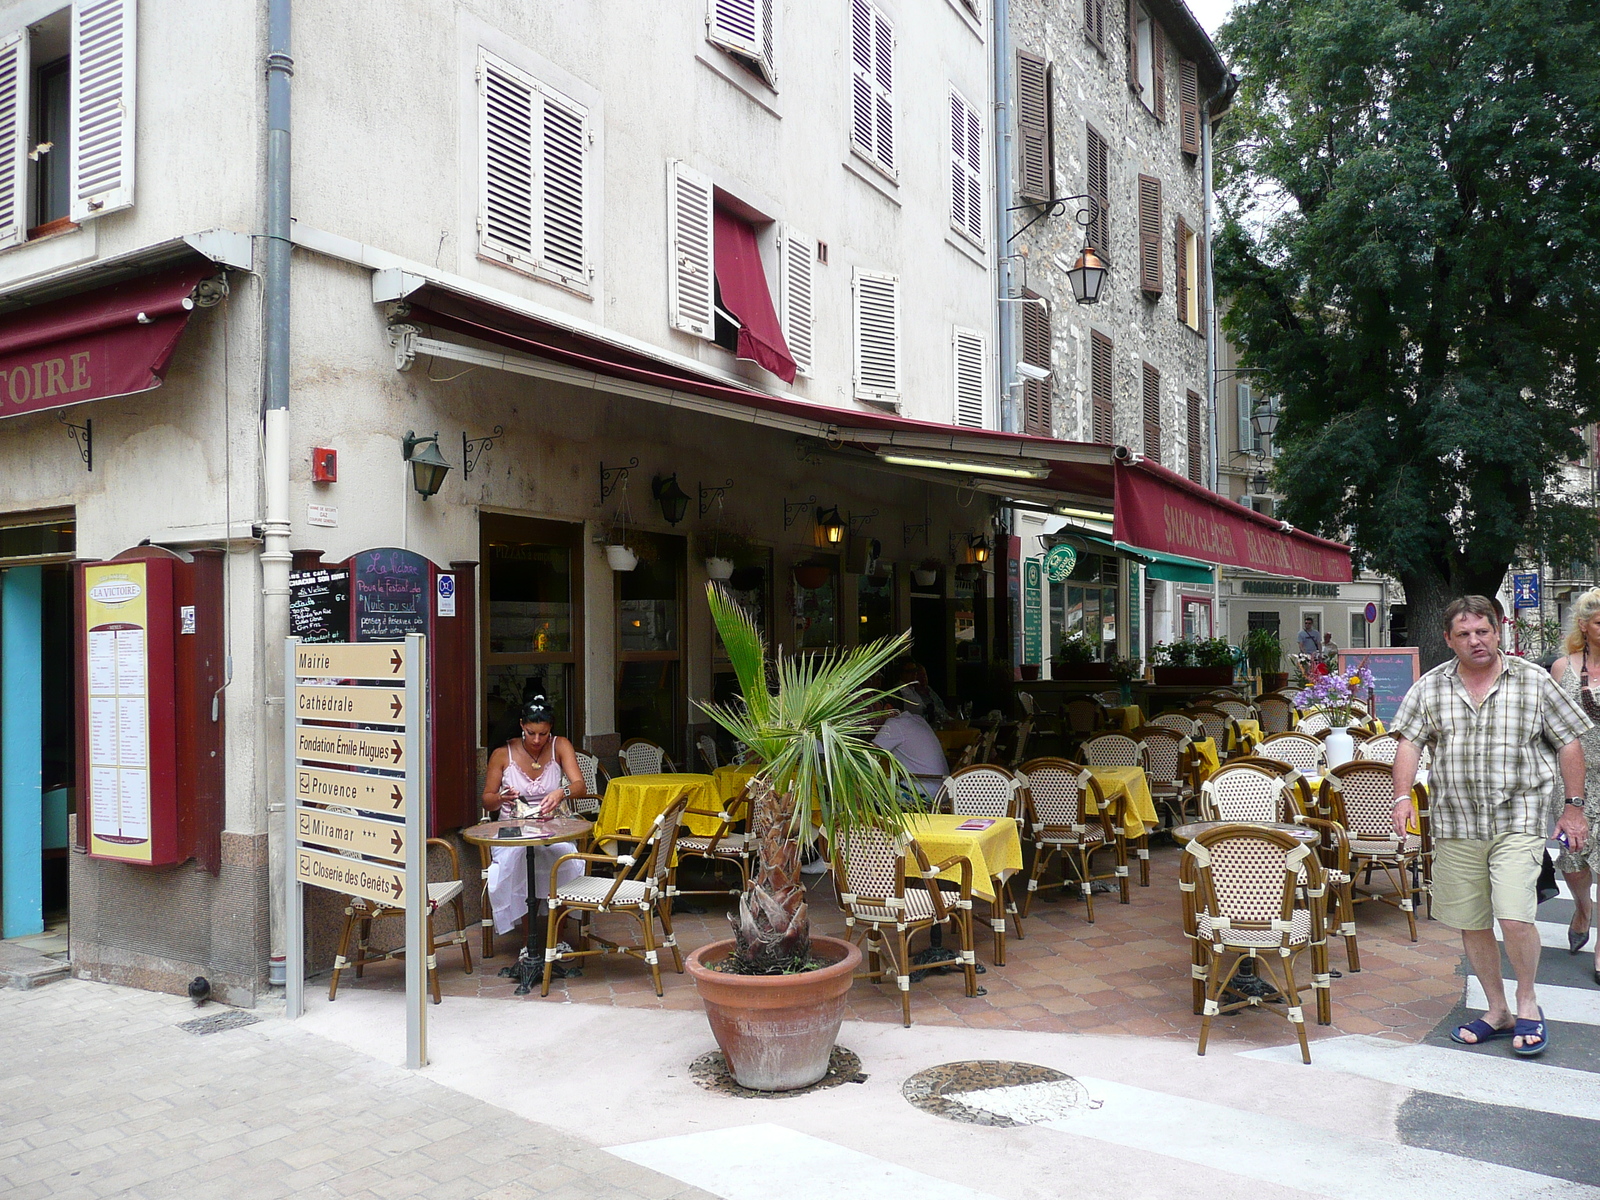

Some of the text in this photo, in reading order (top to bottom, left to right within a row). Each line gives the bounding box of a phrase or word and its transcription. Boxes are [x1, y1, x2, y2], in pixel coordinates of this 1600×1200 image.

[1164, 503, 1200, 550] SNACK
[1198, 516, 1236, 558] GLACIER
[94, 585, 136, 597] LA VICTOIRE
[1243, 581, 1297, 595] PHARMACIE
[298, 653, 330, 669] Mairie
[299, 694, 353, 713] Cathédrale
[299, 734, 389, 762] Fondation Émile Hugues
[312, 777, 357, 798] Provence
[312, 818, 354, 842] Miramar
[312, 860, 390, 894] Closerie des Genêts
